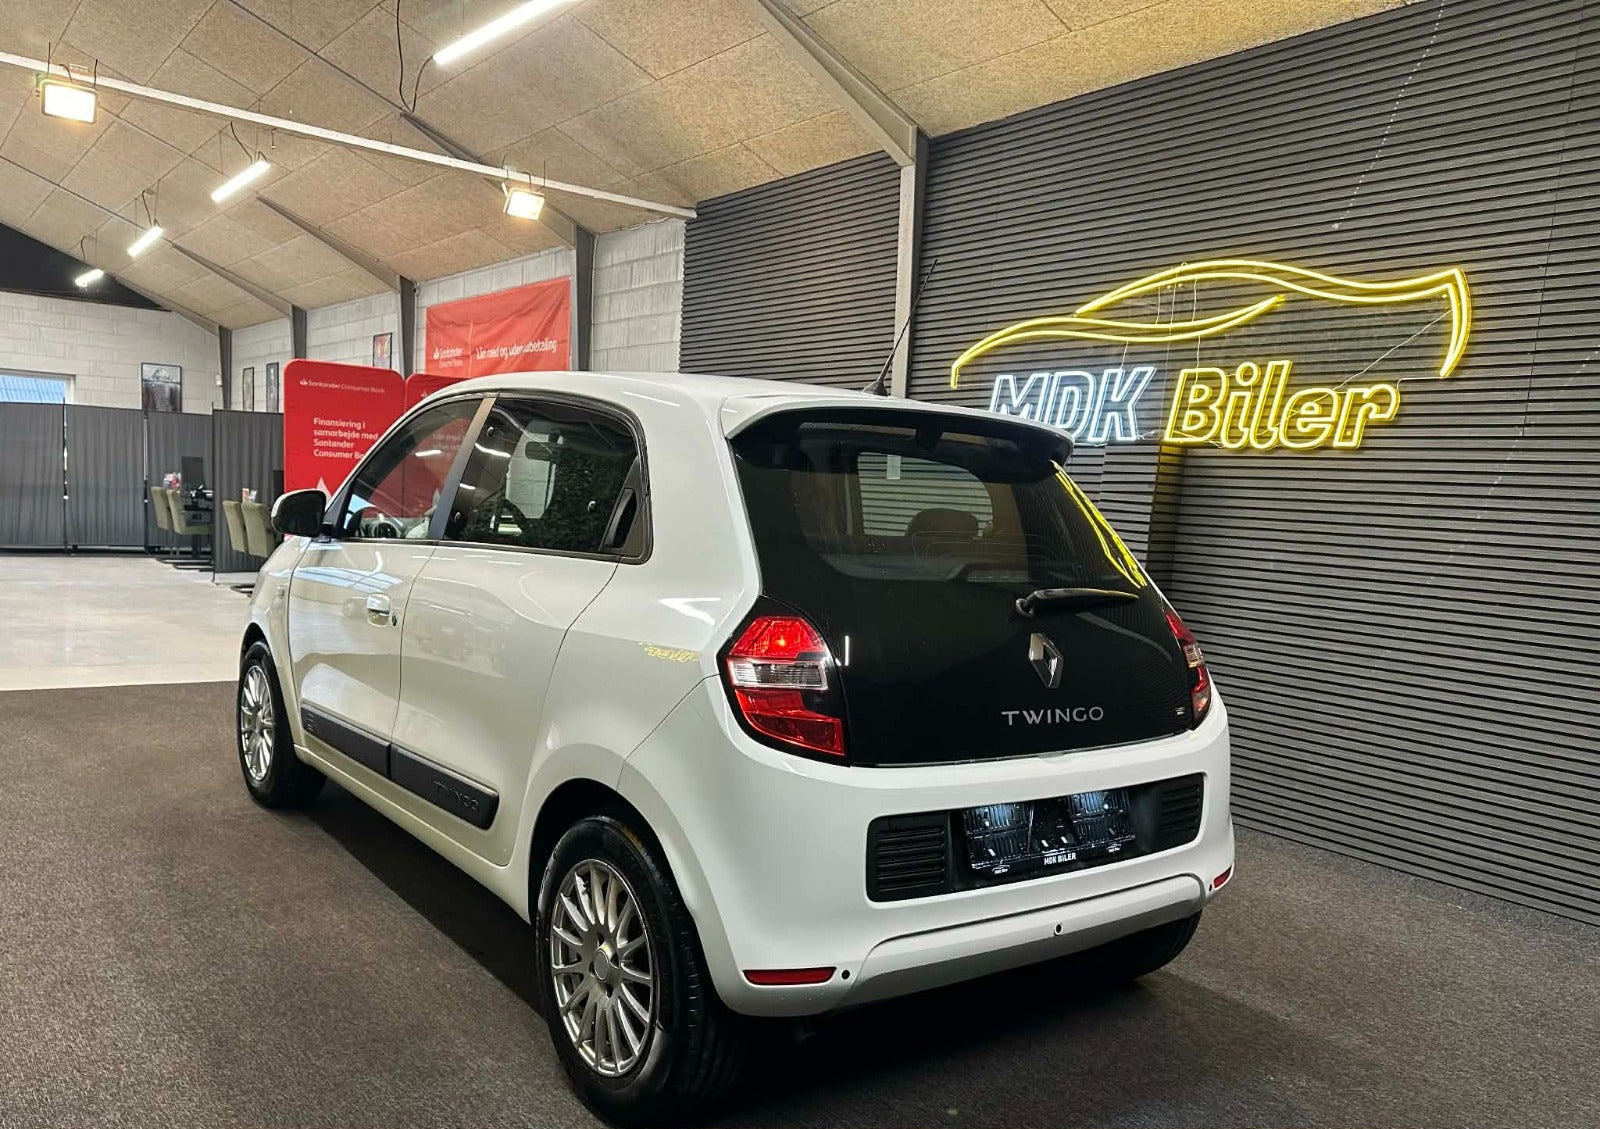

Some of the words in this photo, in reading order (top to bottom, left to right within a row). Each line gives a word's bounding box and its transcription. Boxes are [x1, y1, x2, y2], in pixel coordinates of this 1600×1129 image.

[500, 346, 508, 360] og
[523, 338, 557, 354] betaling
[308, 380, 340, 389] Santander
[341, 383, 370, 393] Consumer
[989, 366, 1157, 443] MDK
[1164, 359, 1401, 451] Biler
[313, 417, 362, 430] Finansiering
[313, 428, 360, 440] samarbejde
[361, 432, 379, 440] med
[313, 438, 355, 449] Santander
[313, 448, 353, 459] Consumer
[354, 450, 366, 460] Ba
[1001, 706, 1105, 726] TWINGO
[1044, 855, 1058, 866] MDK
[1058, 852, 1077, 864] BILER
